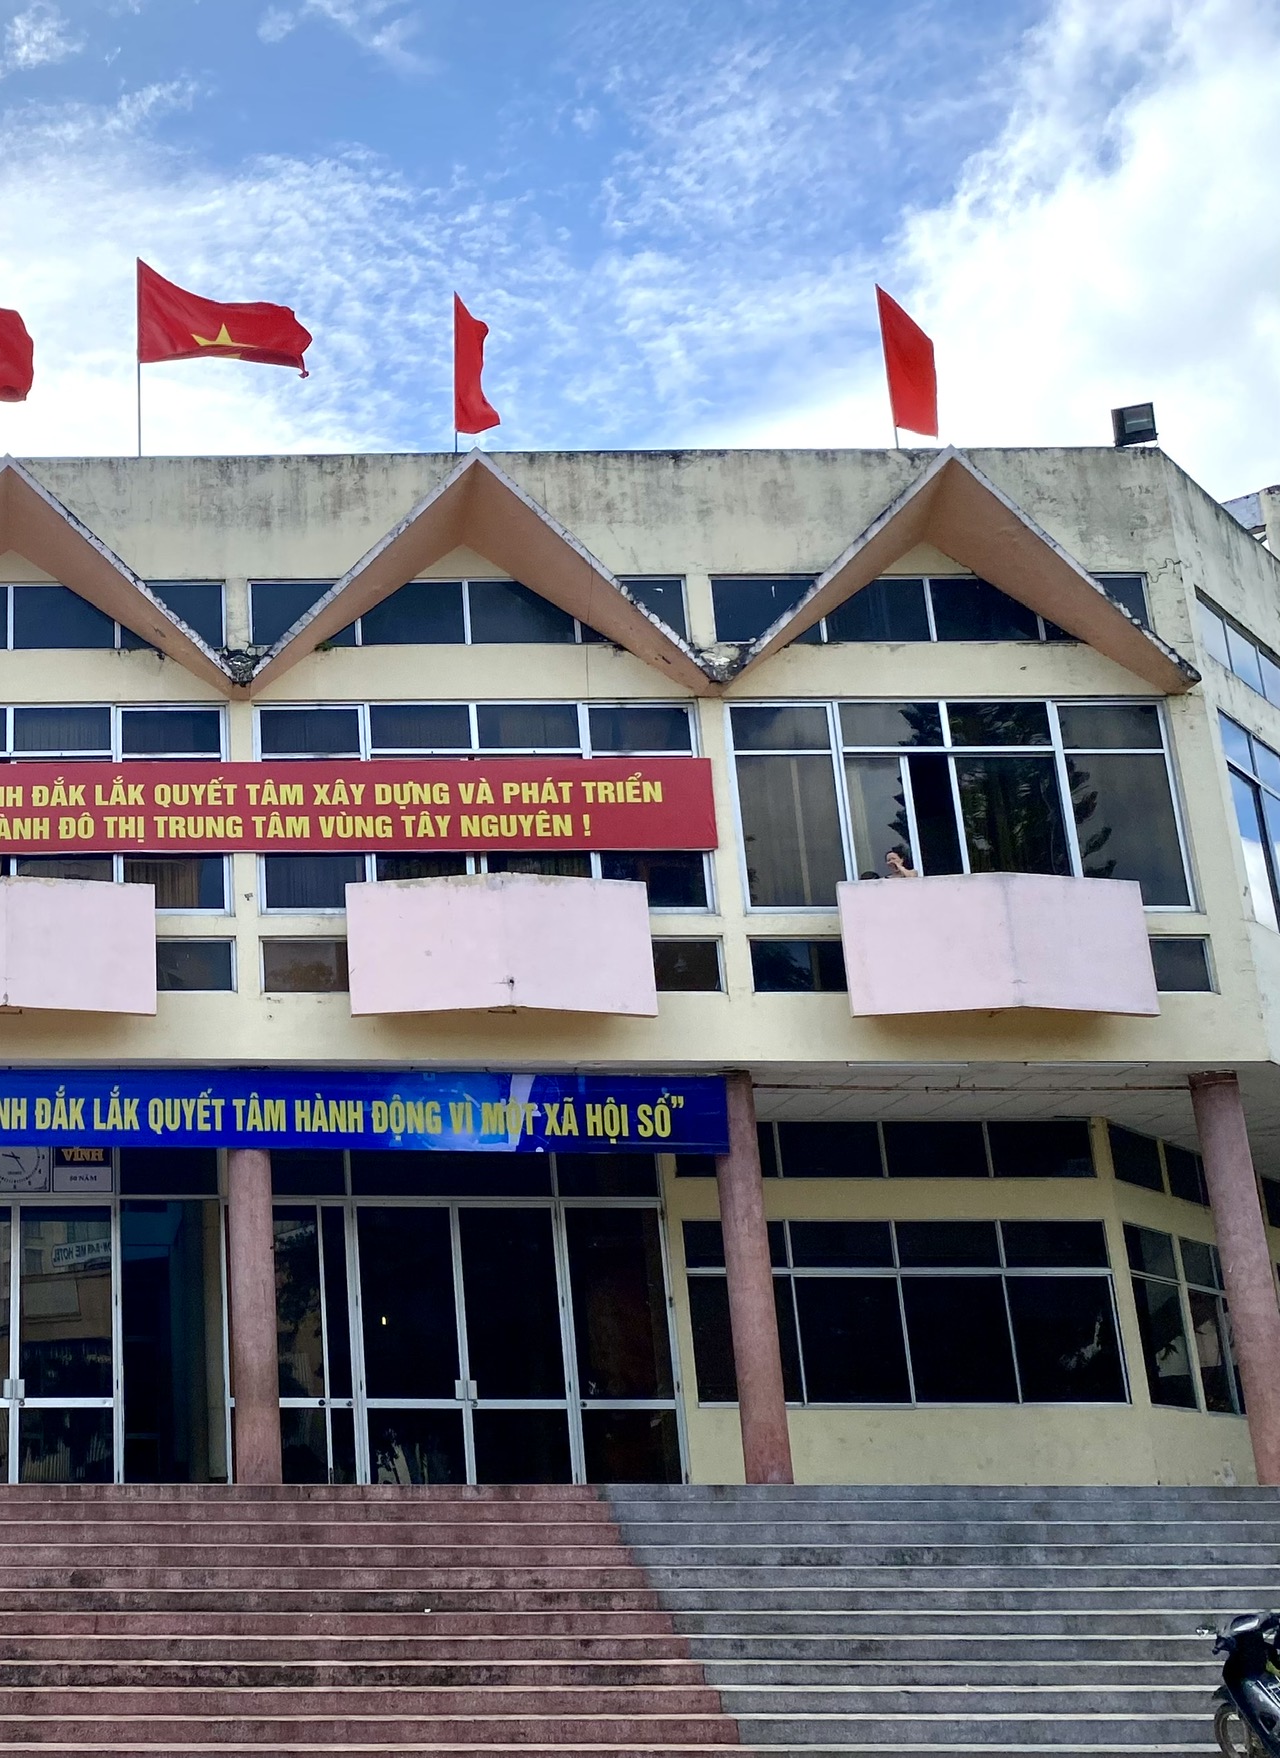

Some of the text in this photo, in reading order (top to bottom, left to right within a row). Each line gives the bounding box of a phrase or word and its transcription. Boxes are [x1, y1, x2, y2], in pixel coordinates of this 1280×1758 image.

[31, 776, 86, 807] ĐẮK
[94, 775, 146, 806] LẮK
[154, 776, 238, 808] QUYẾT
[245, 778, 304, 806] TÂM
[312, 778, 366, 806] XÂY
[374, 779, 451, 810] DỰNG
[457, 777, 495, 805] VÀ
[502, 776, 574, 804] PHÁT
[580, 771, 663, 804] TRIỂN
[57, 810, 95, 840] ĐÔ
[102, 815, 145, 843] THỊ
[153, 815, 243, 839] TRUNG
[251, 811, 311, 839] TÂM
[318, 811, 393, 839] VÙNG
[400, 810, 451, 838] TÂY
[460, 809, 573, 838] NGUYÊN
[582, 812, 591, 837] !
[35, 1085, 85, 1131] ĐẮK
[94, 1085, 140, 1131] LẮK
[148, 1088, 225, 1135] QUYẾT
[232, 1092, 286, 1132] TÂM
[295, 1092, 364, 1133] HÀNH
[372, 1094, 442, 1141] ĐỘNG
[544, 1097, 579, 1136] XÃ
[586, 1097, 629, 1144] HỘI
